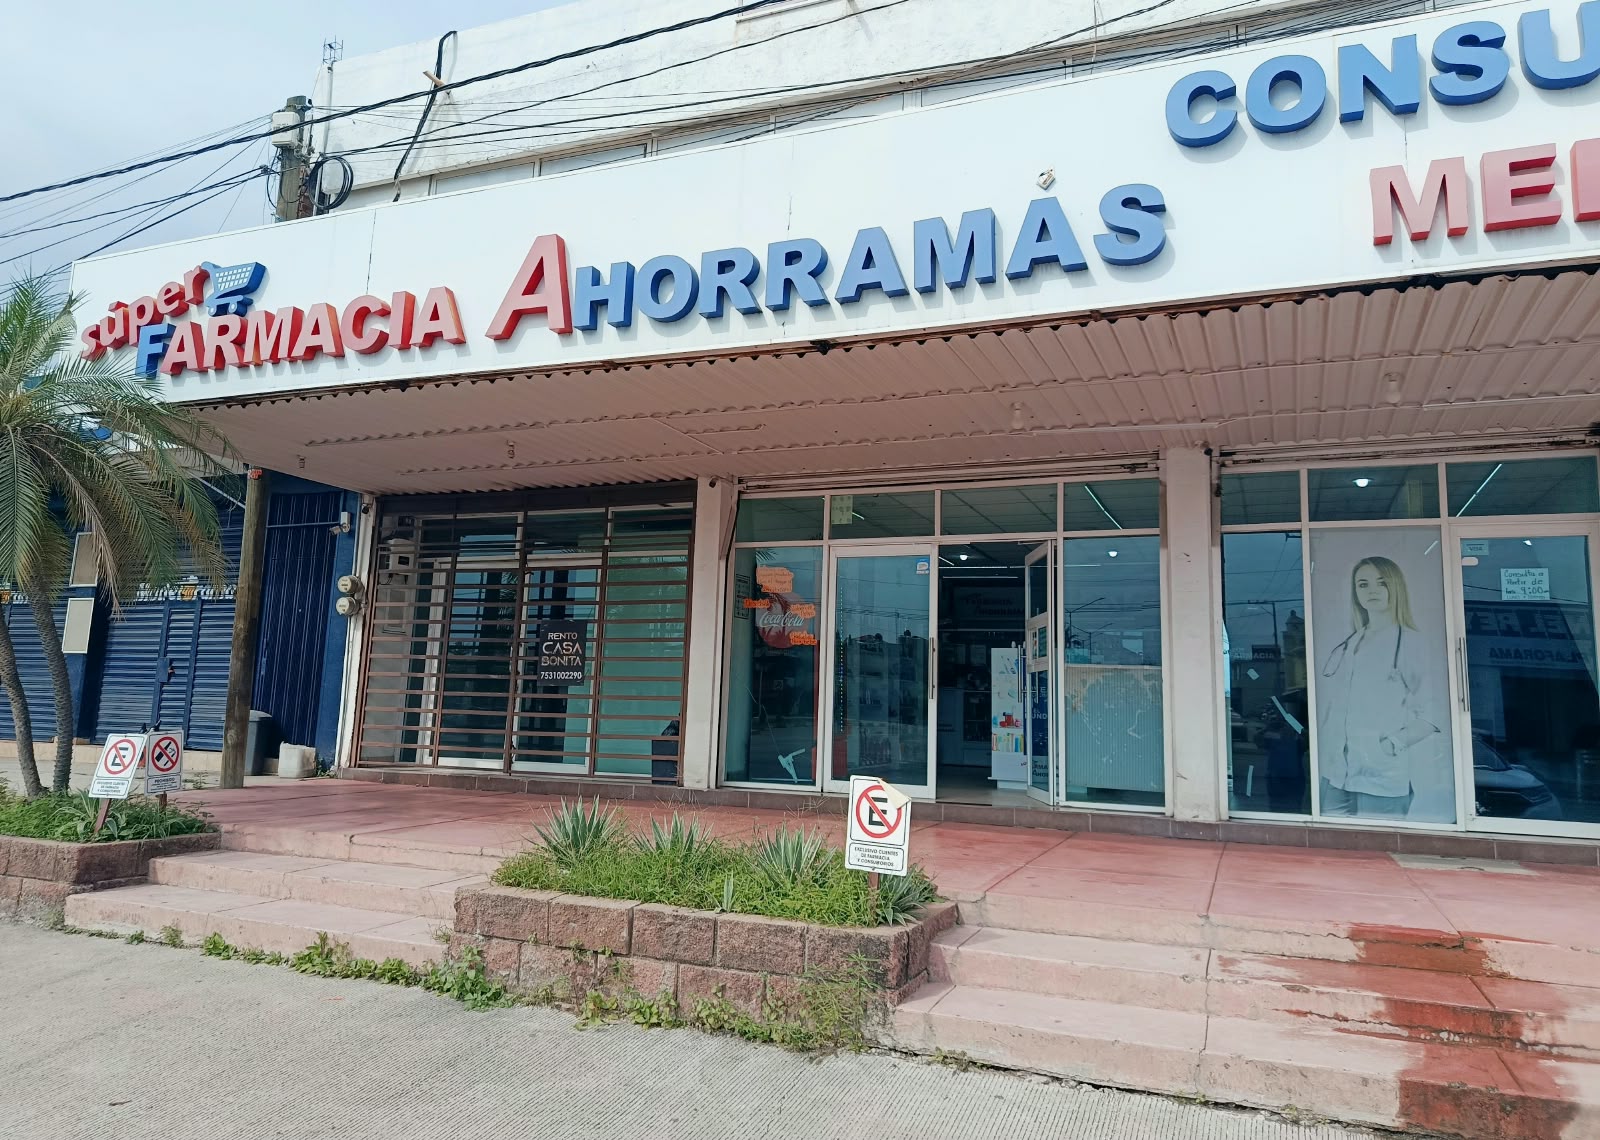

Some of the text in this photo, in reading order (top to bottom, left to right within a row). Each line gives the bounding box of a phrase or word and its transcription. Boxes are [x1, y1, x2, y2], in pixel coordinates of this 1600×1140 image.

[1165, 1, 1600, 148] CONSU
[135, 286, 466, 380] FARMACIA
[547, 632, 578, 640] RENTO
[542, 641, 582, 655] CASA
[541, 656, 582, 666] BONITA
[540, 671, 582, 680] 7531002290
